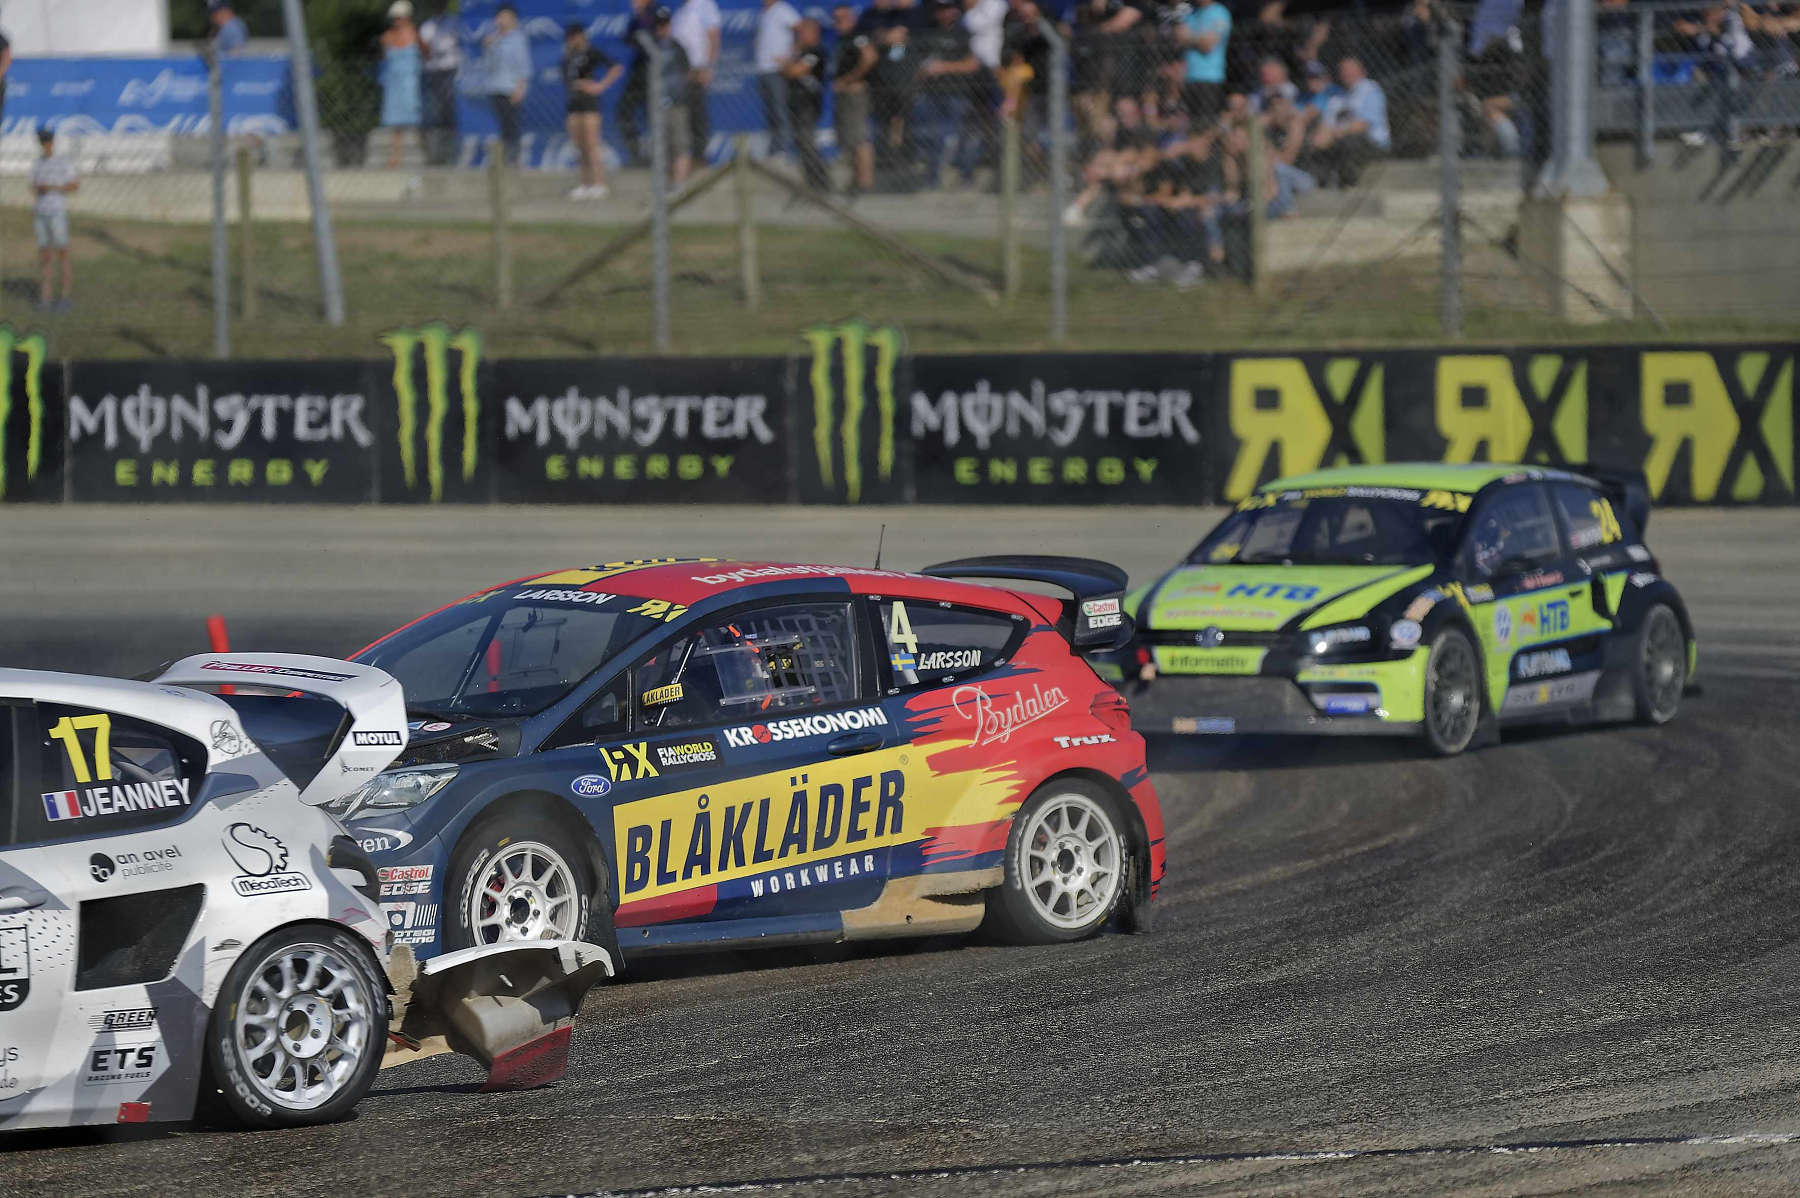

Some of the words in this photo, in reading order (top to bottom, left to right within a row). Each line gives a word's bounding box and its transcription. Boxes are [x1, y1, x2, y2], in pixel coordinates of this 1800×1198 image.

[68, 383, 374, 452] MONSTER
[505, 385, 774, 449] MONSTER
[910, 379, 1200, 449] MONSTER
[115, 458, 330, 486] ENERGY
[546, 454, 735, 480] ENERGY
[954, 456, 1160, 484] ENERGY
[513, 589, 616, 605] LARSSON
[890, 601, 918, 653] 4
[1088, 614, 1121, 628] EDGE
[1539, 599, 1570, 636] HTB
[918, 650, 982, 671] LARSSON
[952, 682, 1068, 749] Bydalen
[48, 713, 112, 783] 17
[355, 732, 400, 745] MOTUL
[661, 751, 717, 767] RALLYCROSS
[82, 778, 192, 817] JEANNEY
[578, 775, 605, 795] Ford
[624, 769, 905, 894] BLÅKLÄDER
[144, 845, 182, 861] avel
[390, 866, 430, 880] Castrol
[751, 855, 875, 898] WORKWEAR
[380, 881, 432, 896] EDGE
[104, 1009, 159, 1030] GREEN
[91, 1047, 156, 1072] ETS
